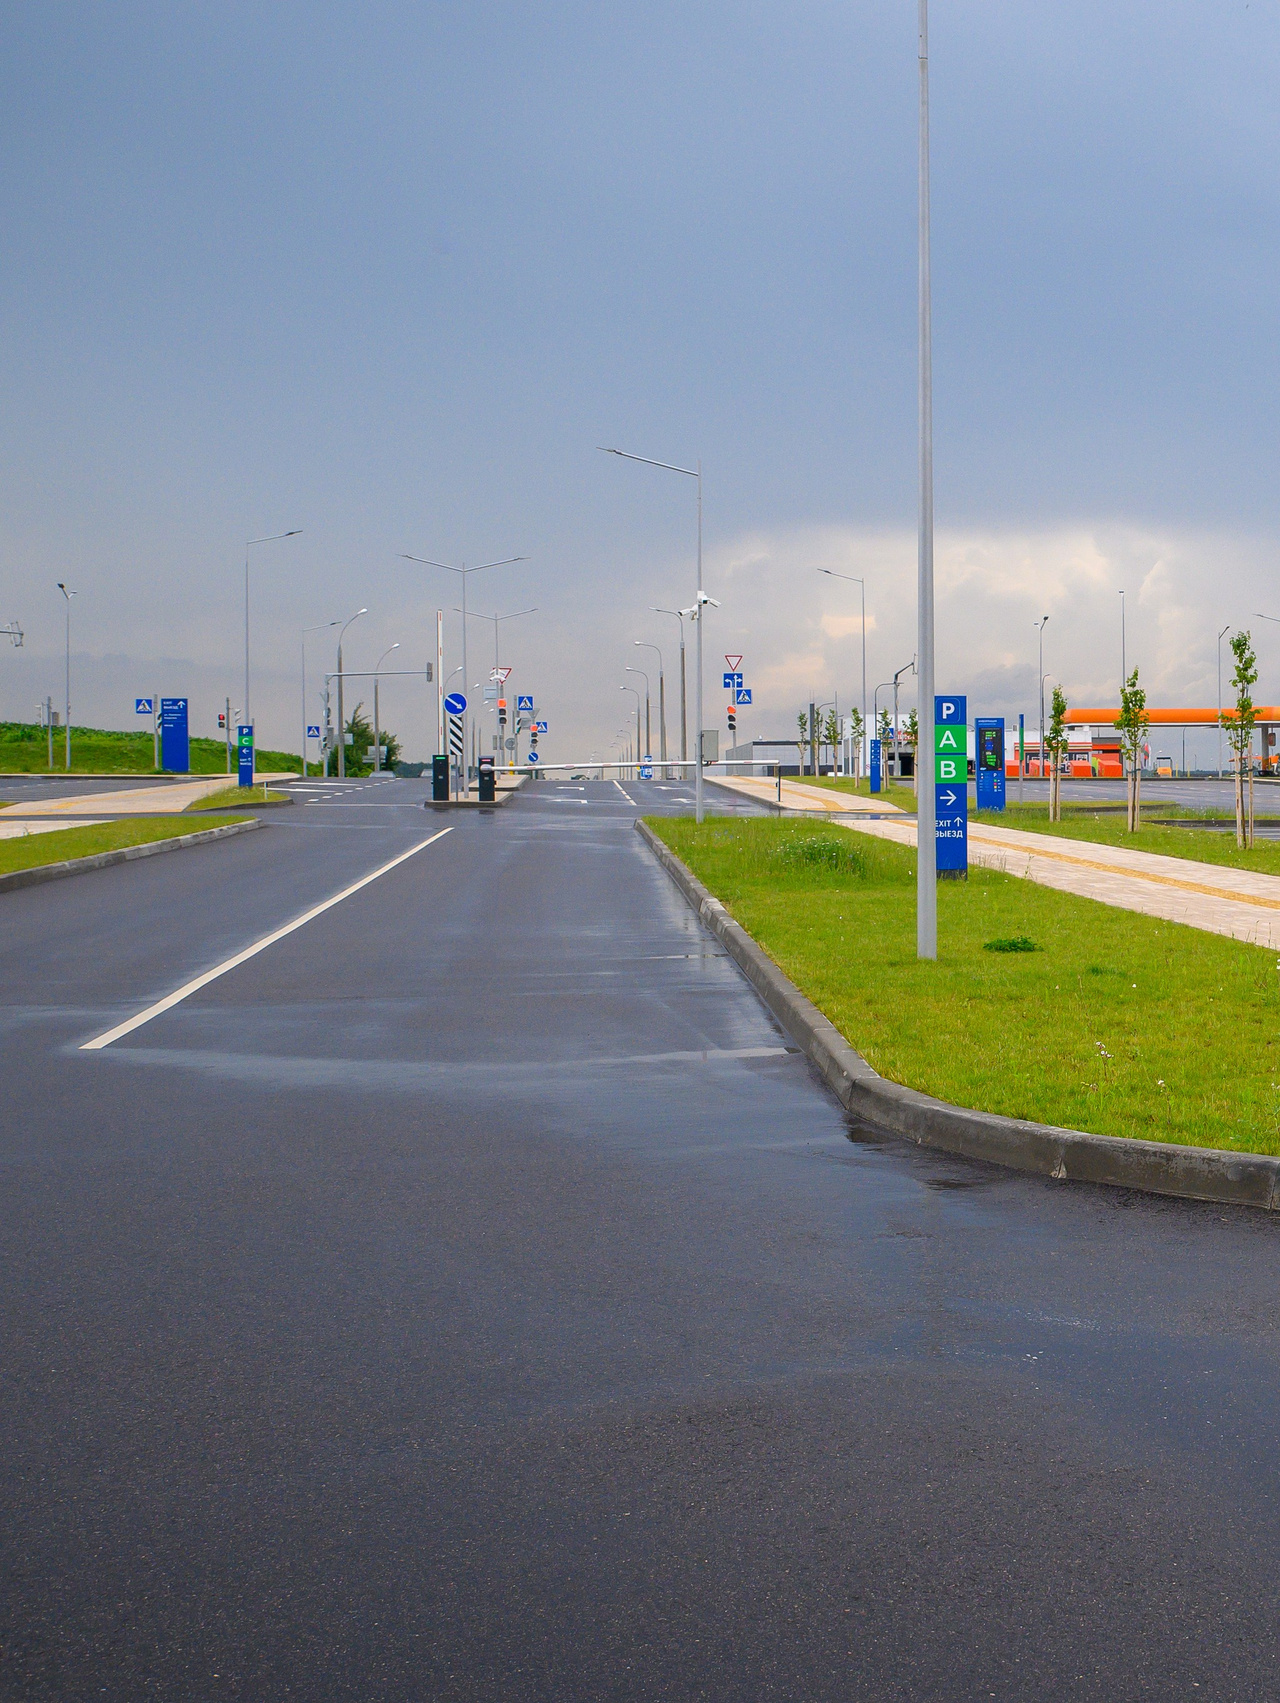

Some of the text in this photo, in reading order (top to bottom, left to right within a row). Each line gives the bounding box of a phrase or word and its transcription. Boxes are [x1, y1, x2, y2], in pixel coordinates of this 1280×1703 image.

[942, 703, 955, 719] P
[939, 730, 957, 748] A
[940, 761, 956, 778] B
